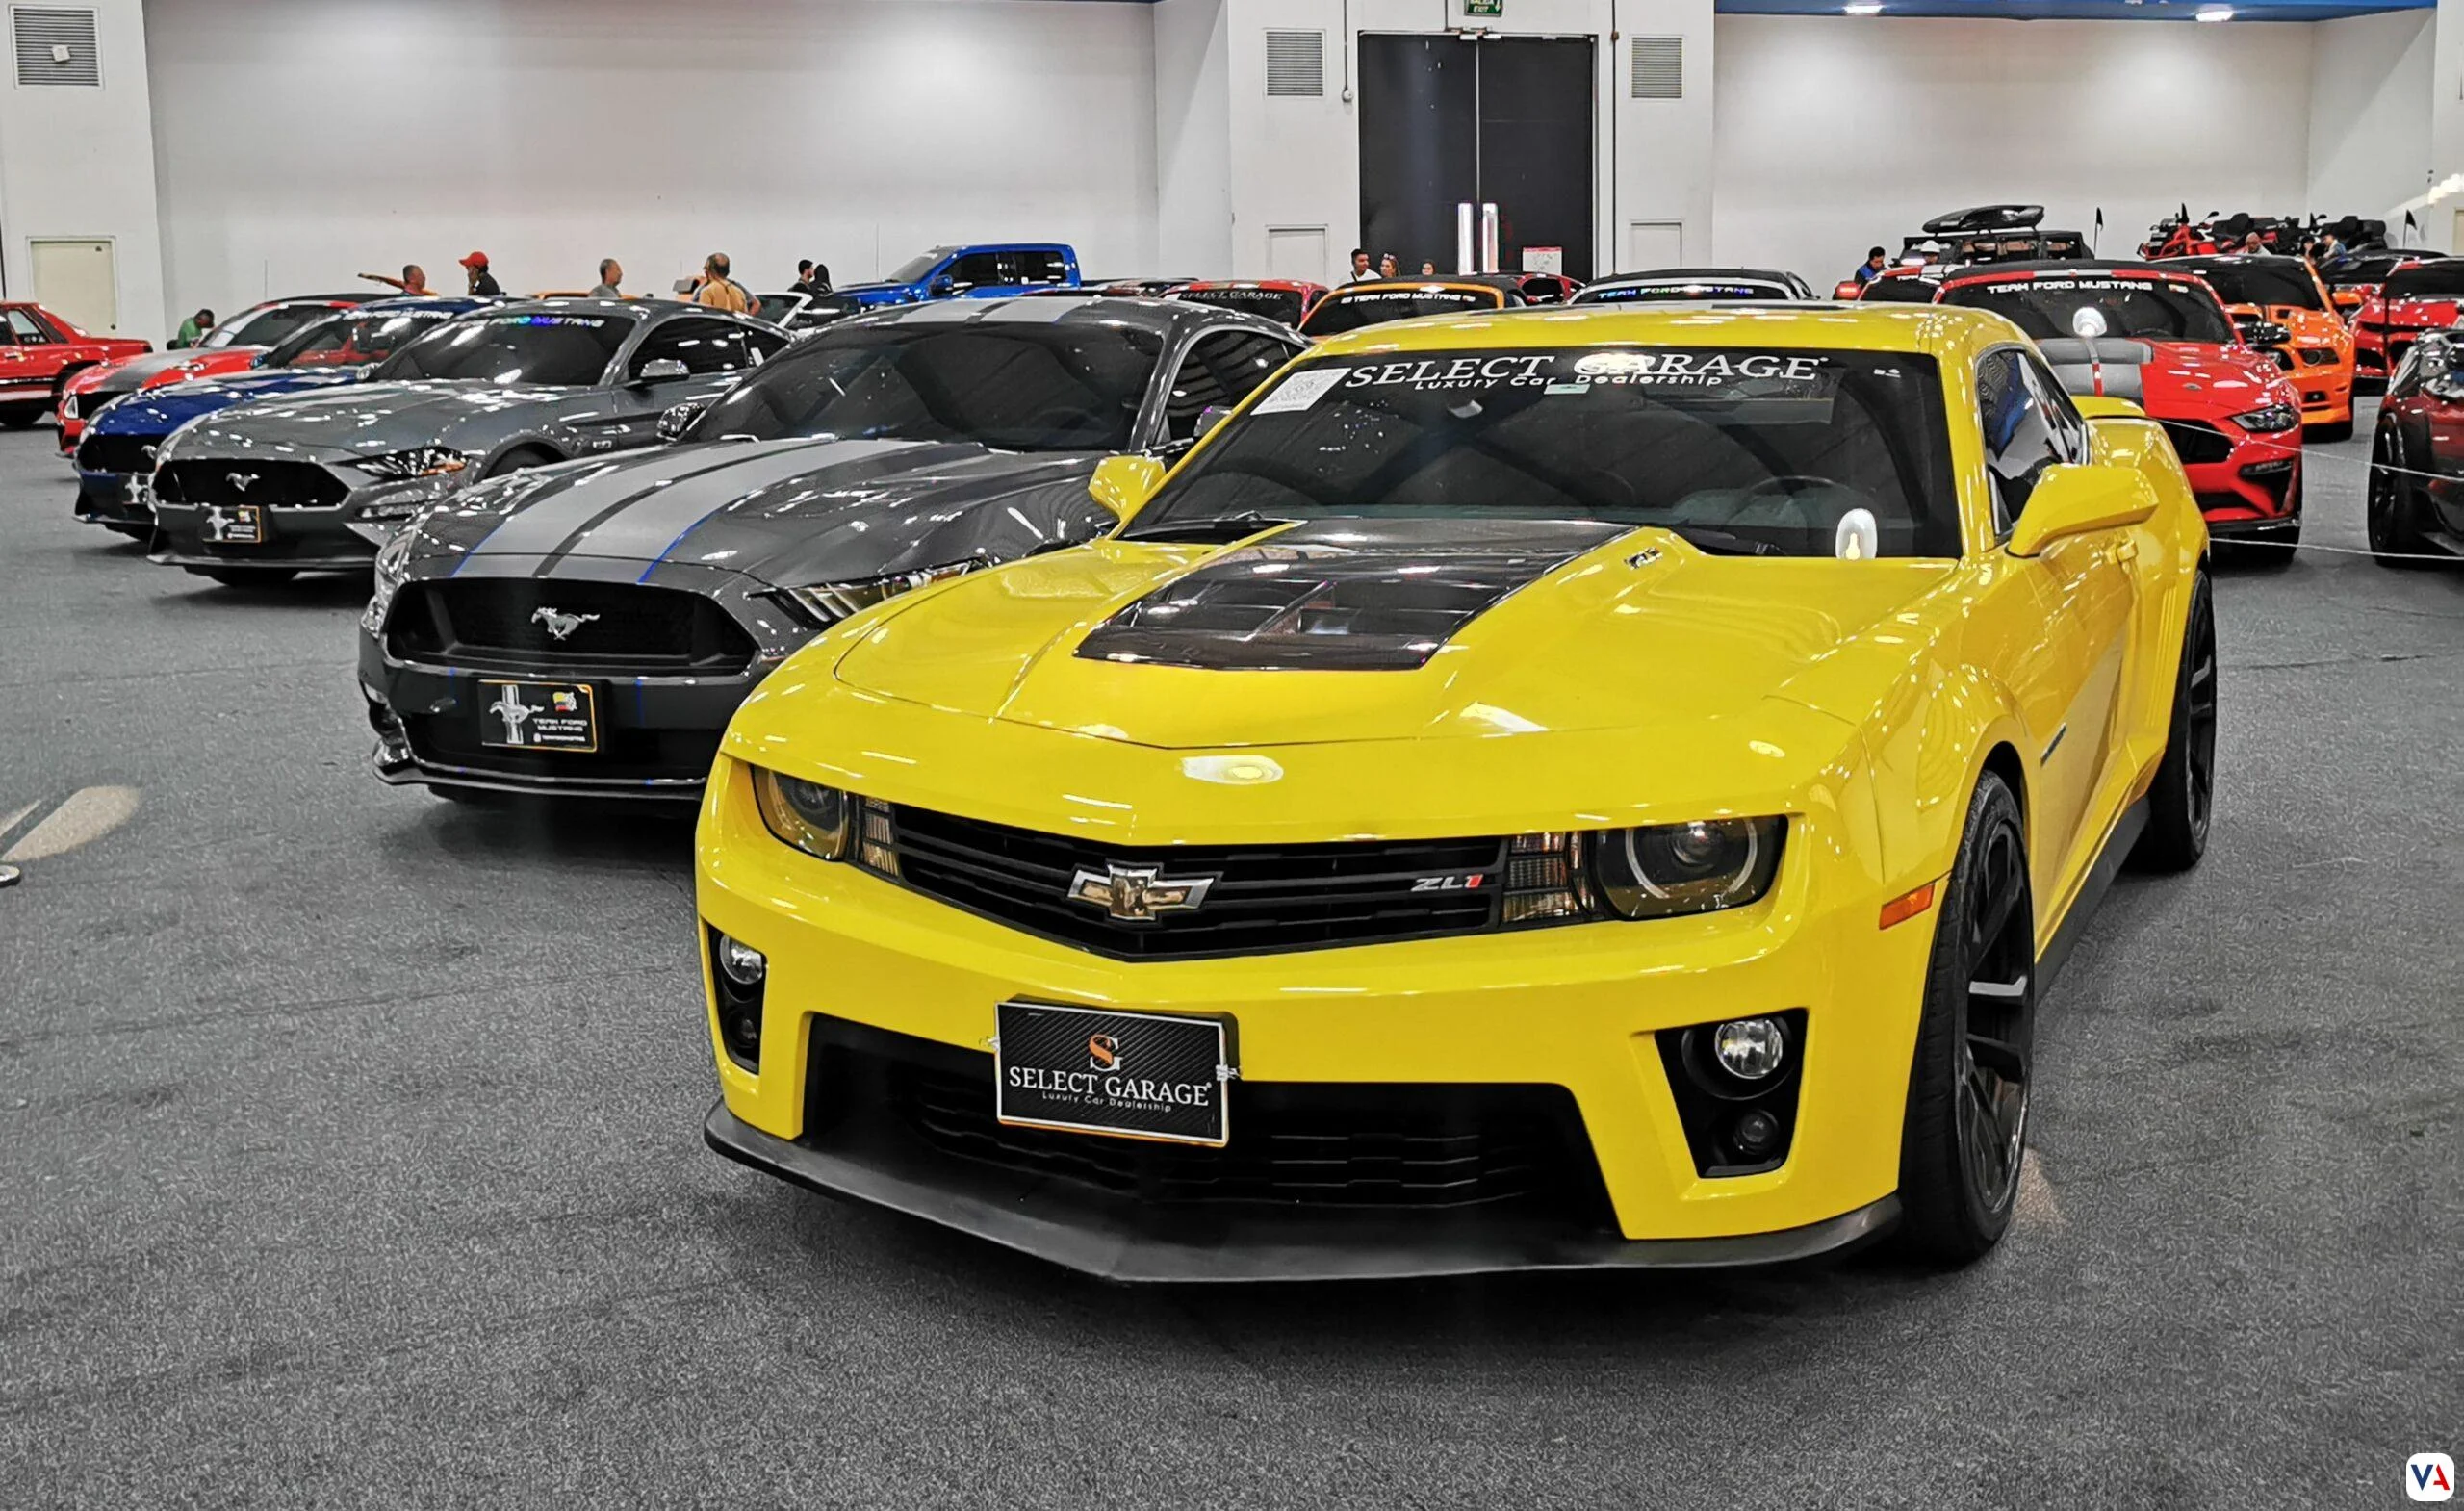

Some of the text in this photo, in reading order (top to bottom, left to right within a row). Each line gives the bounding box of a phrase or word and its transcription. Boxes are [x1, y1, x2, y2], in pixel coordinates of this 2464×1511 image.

[1598, 290, 1636, 299] TEAM
[1987, 280, 2153, 295] TEAM FORD MUSTANG
[1181, 291, 1283, 301] SELECT GARAGE
[1354, 294, 1381, 303] TEAM
[1412, 292, 1461, 301] MUSTANG
[531, 315, 605, 328] MUSTANG
[1346, 356, 1555, 388] SELECT
[1414, 373, 1723, 390] Luxury Car Dealership
[1410, 874, 1484, 892] ZL1
[1010, 1065, 1098, 1094] SELECT
[1042, 1091, 1172, 1113] Luxury Car Dealership
